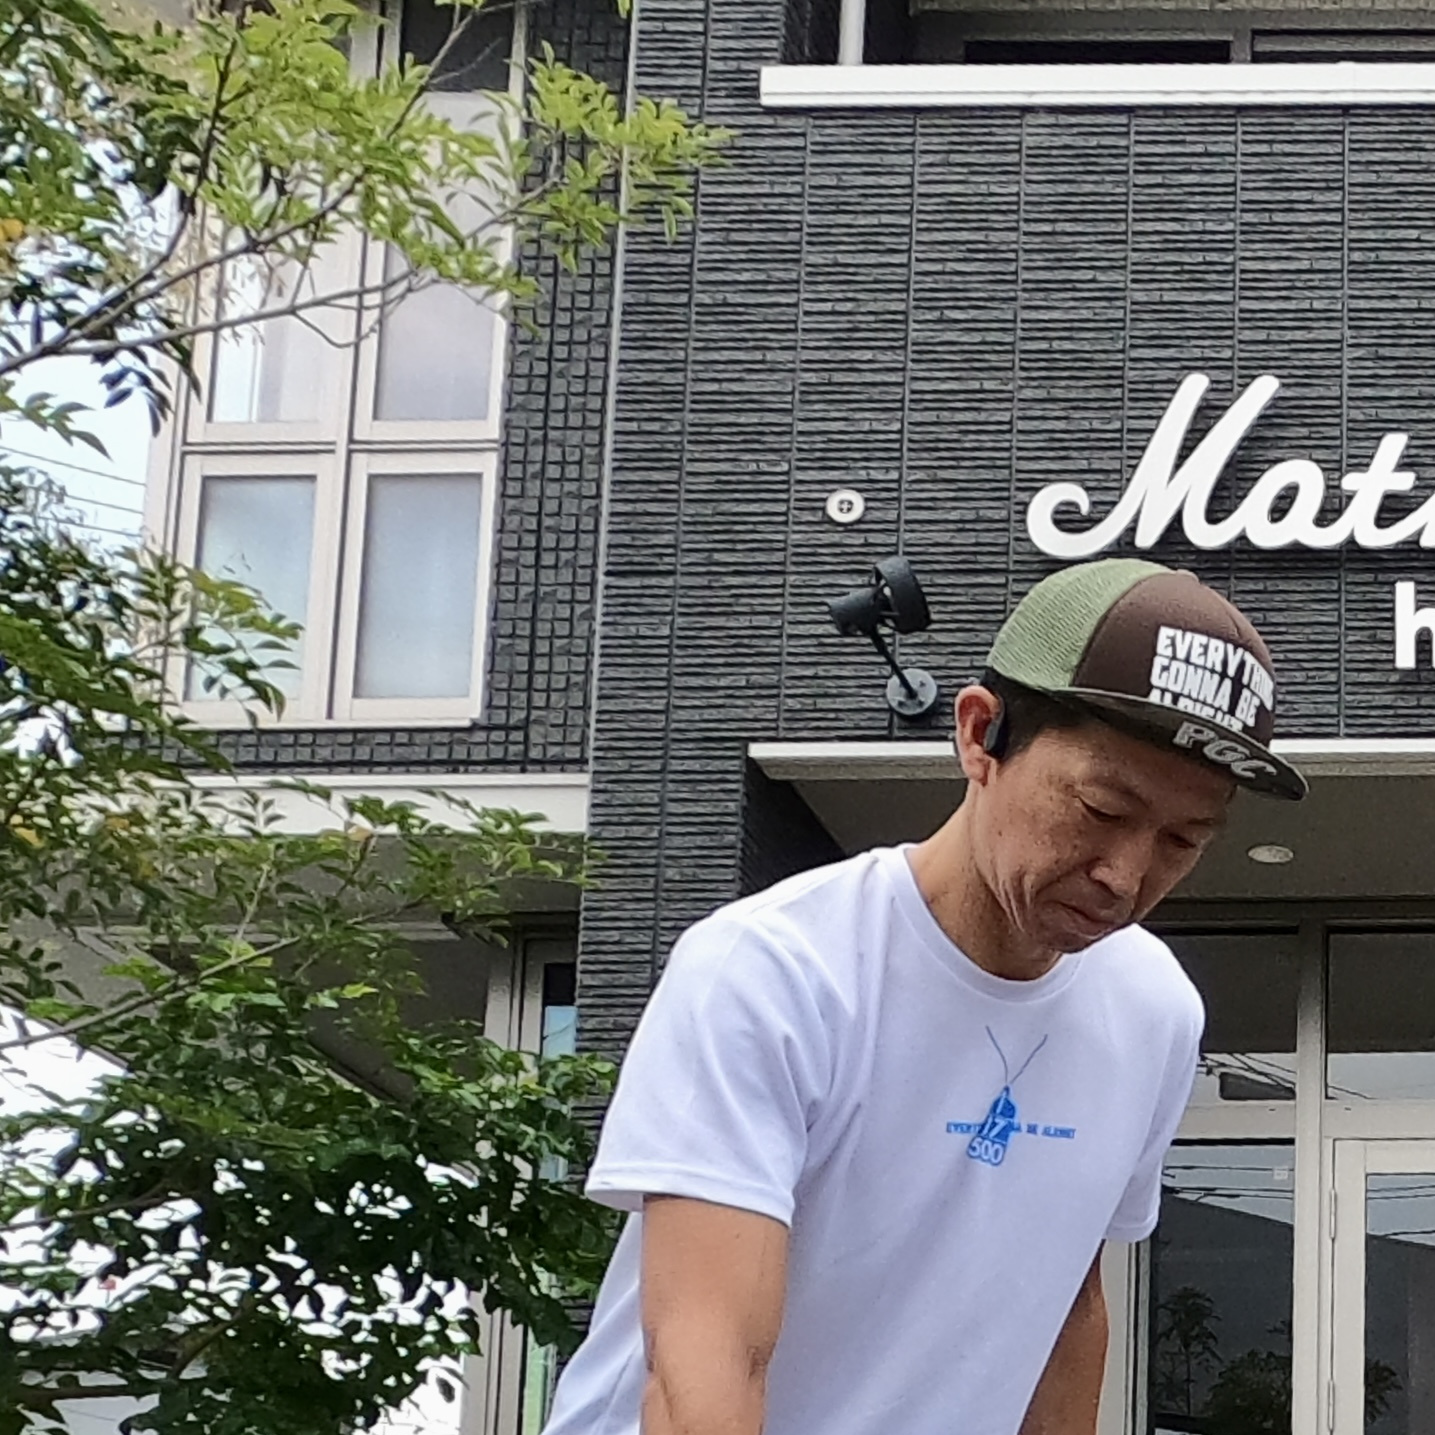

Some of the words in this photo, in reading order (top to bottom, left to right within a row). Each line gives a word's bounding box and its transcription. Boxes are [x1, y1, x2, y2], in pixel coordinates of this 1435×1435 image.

[1150, 655, 1233, 712] GONNA
[1235, 688, 1261, 727] BE
[967, 1136, 1005, 1165] 500
